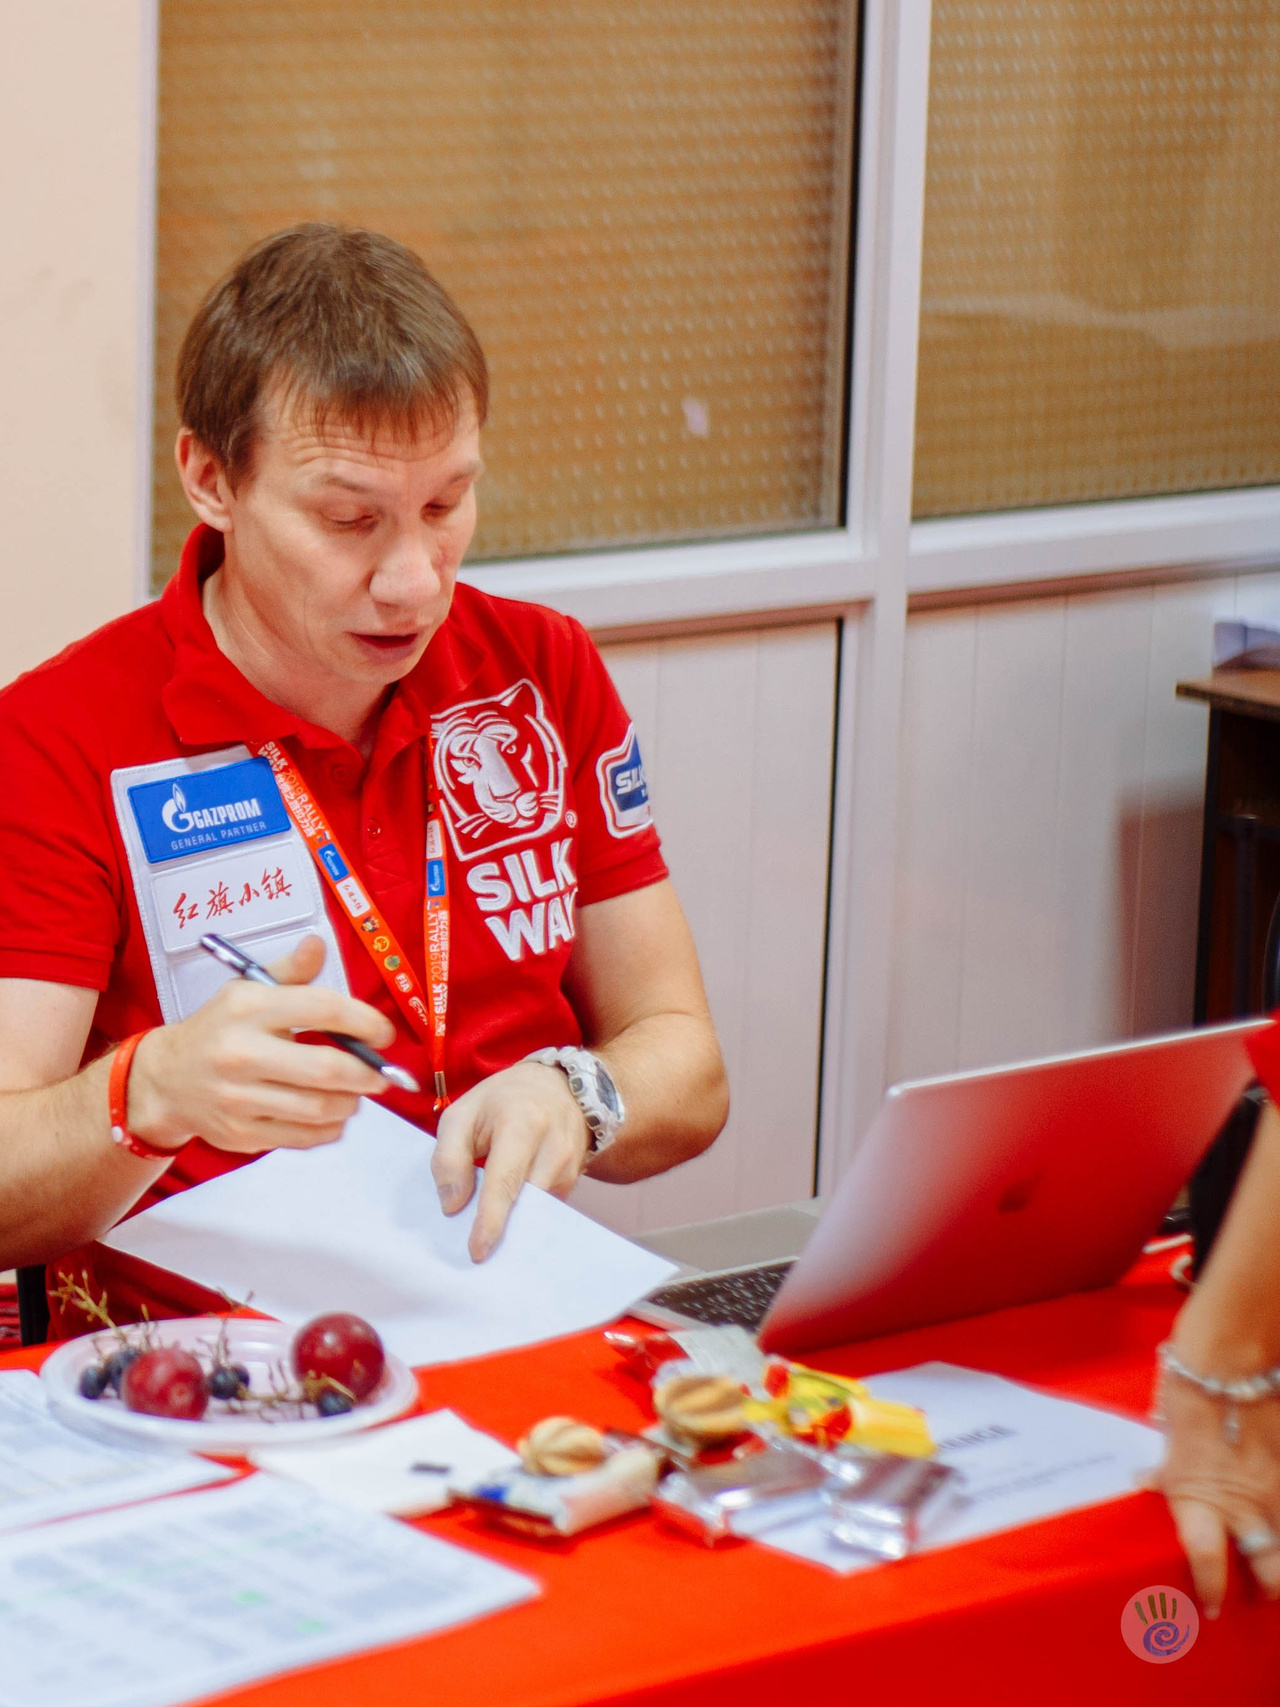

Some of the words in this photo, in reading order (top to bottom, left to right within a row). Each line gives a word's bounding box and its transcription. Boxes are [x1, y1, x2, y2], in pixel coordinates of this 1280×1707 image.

[265, 741, 288, 770] SILK
[283, 769, 303, 796] 2019
[296, 793, 325, 831] RALLY
[193, 798, 262, 829] GAZPROM
[170, 832, 218, 851] GENERAL
[220, 821, 267, 839] PARTNER
[466, 837, 577, 911] SILK
[173, 866, 293, 929] 红旗小镇
[427, 912, 439, 952] RALLY
[484, 886, 578, 962] WAY
[396, 974, 411, 991] FIA
[430, 952, 441, 982] 2019
[432, 982, 443, 1014] SILK
